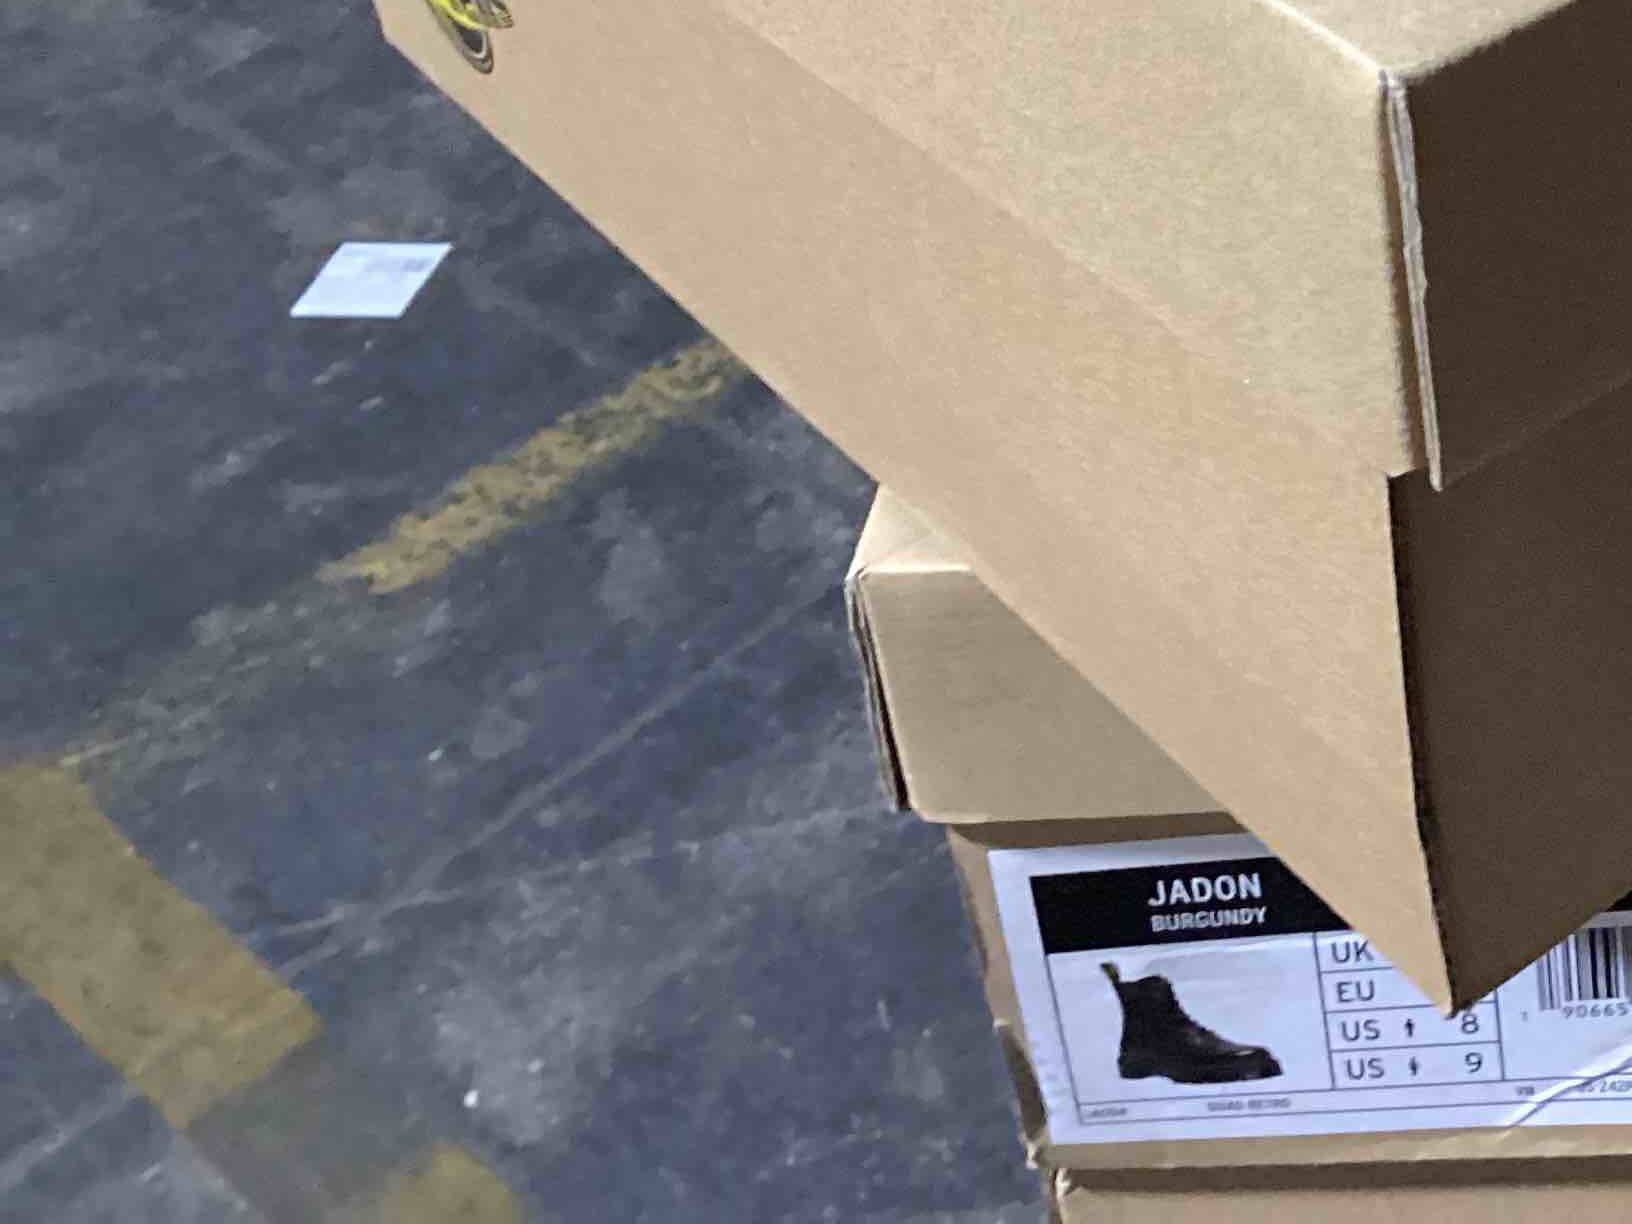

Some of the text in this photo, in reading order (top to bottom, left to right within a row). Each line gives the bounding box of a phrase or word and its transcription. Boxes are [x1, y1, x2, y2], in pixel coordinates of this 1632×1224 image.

[1147, 872, 1262, 907] JADON
[1151, 906, 1267, 933] BURGUNDY
[1331, 940, 1375, 964] UK
[1336, 980, 1375, 1003] EU
[1562, 1004, 1628, 1019] 90665
[1341, 1013, 1481, 1042] US 8
[1346, 1052, 1483, 1080] US 9
